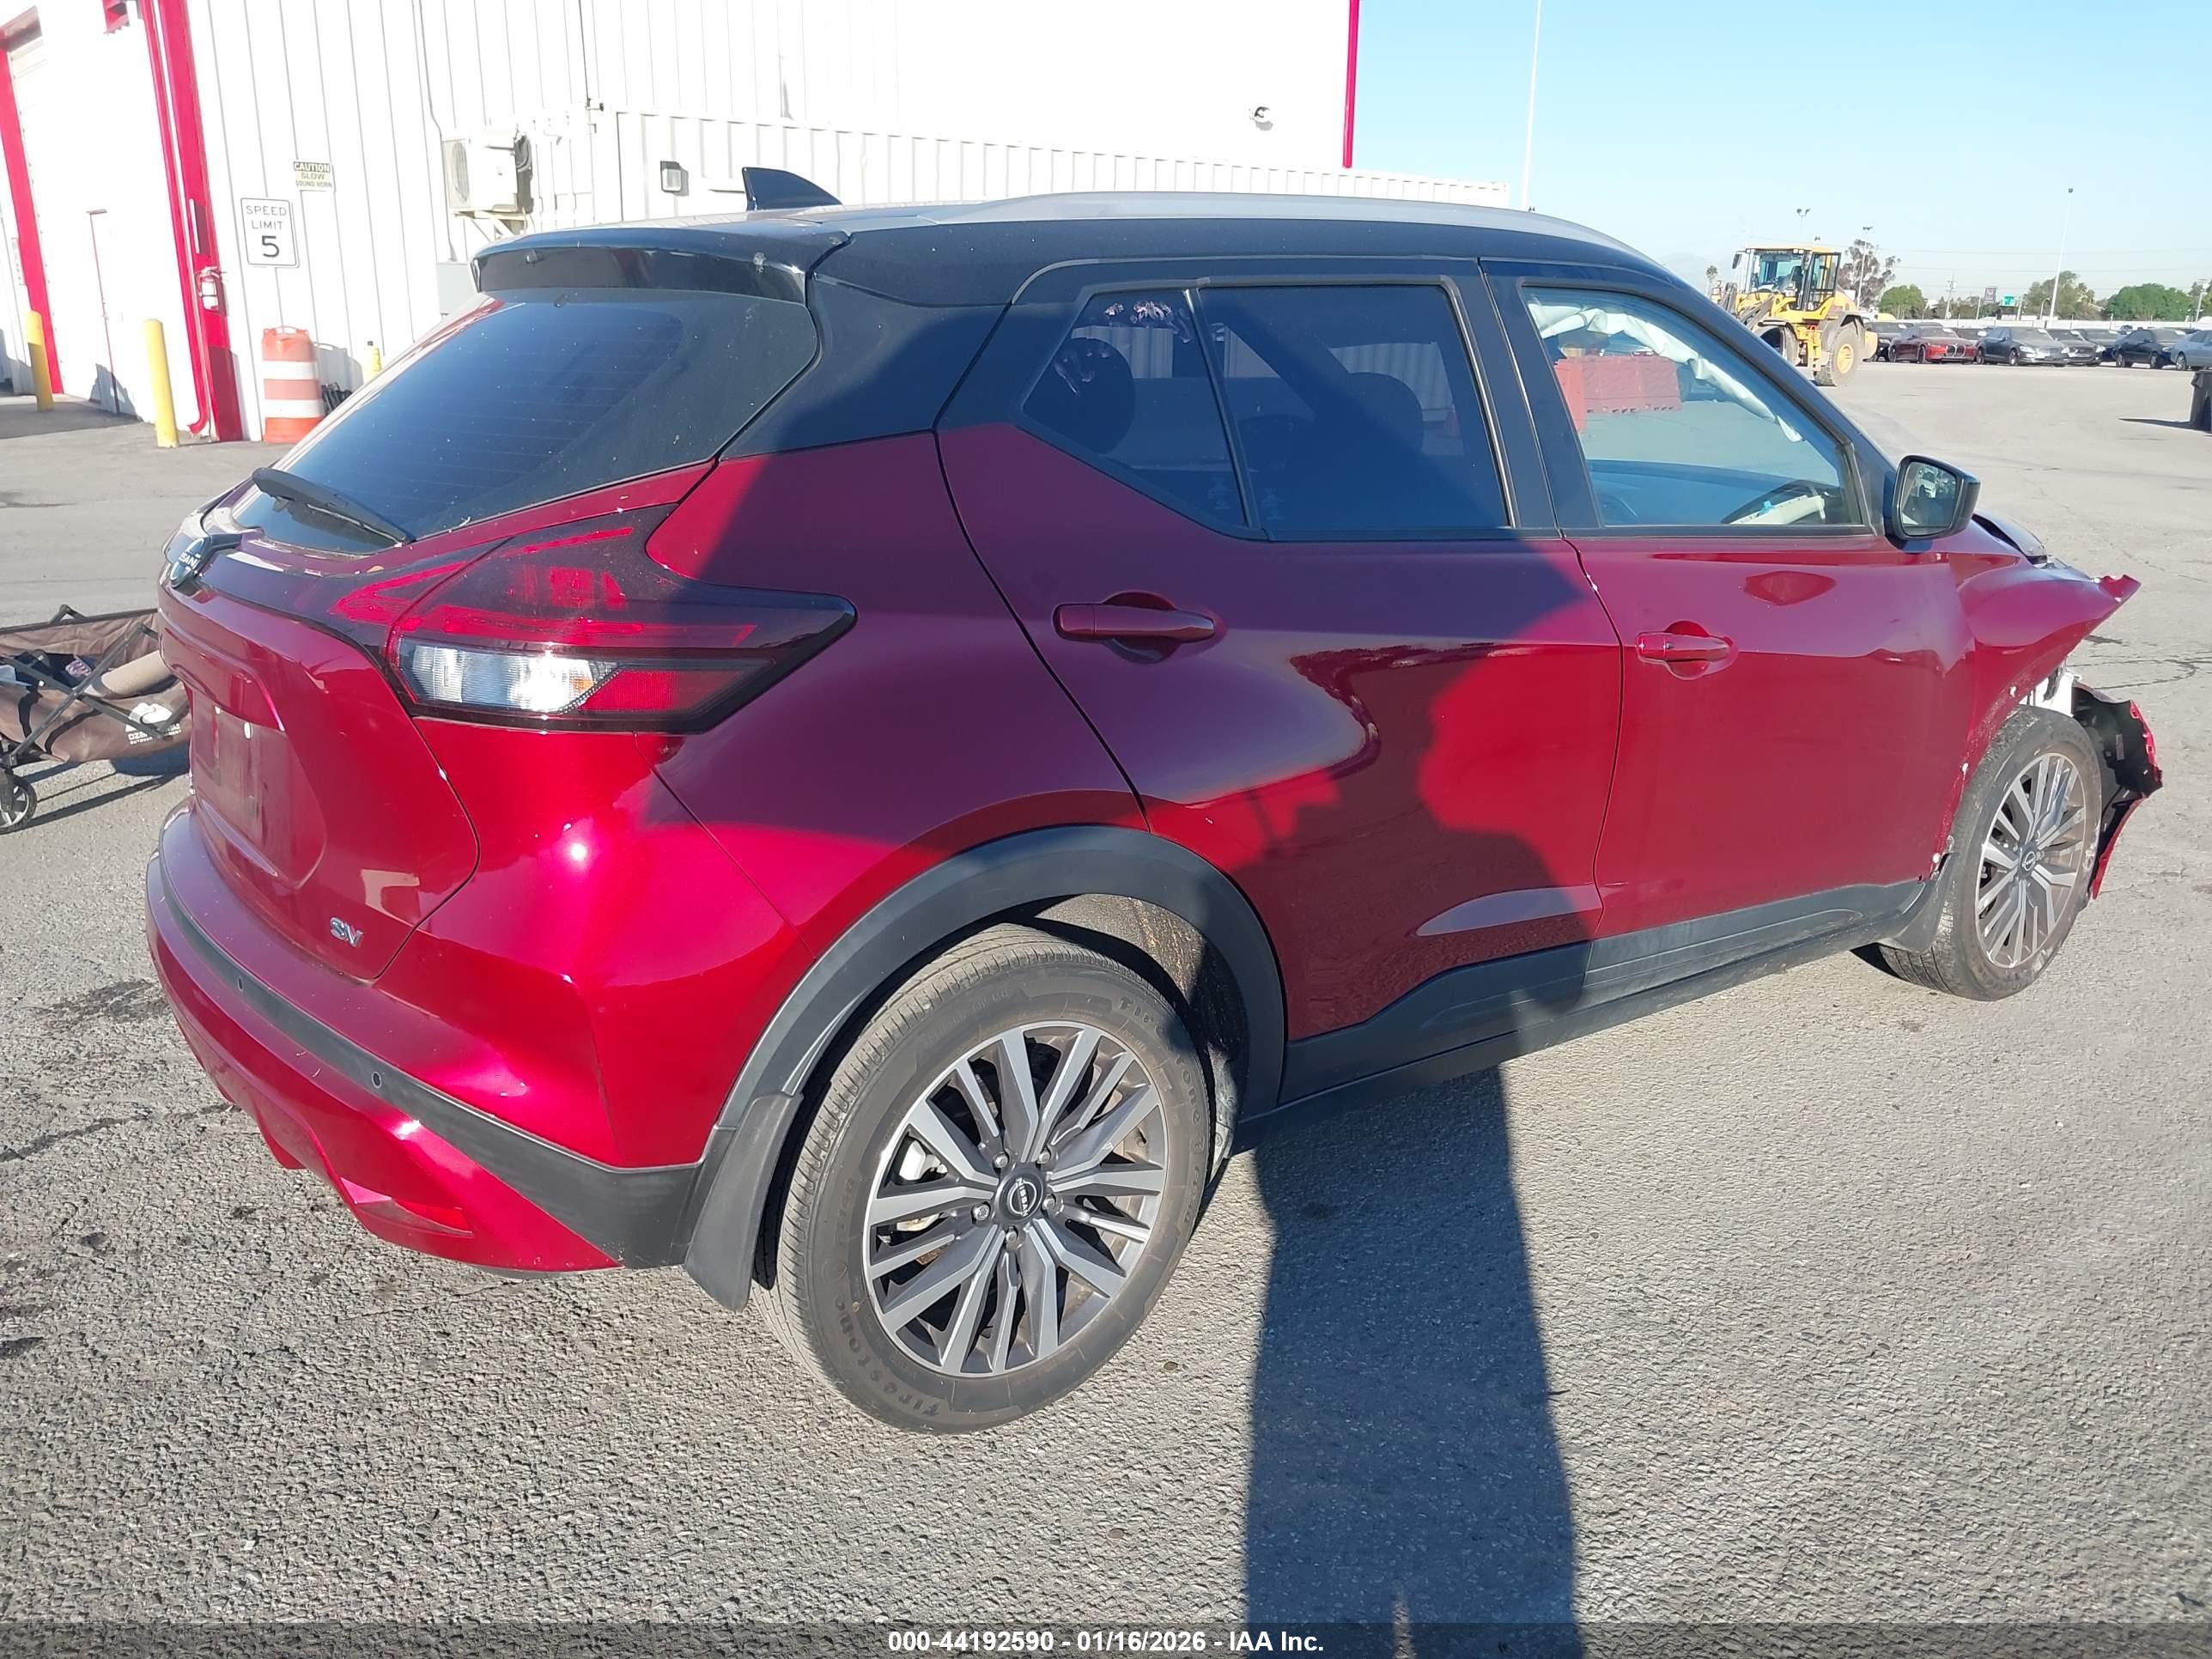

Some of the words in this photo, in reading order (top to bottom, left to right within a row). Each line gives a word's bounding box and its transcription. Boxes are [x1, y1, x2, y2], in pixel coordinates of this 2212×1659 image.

[295, 162, 330, 173] CAUTION
[246, 205, 287, 216] SPEED
[252, 220, 283, 230] LIMIT
[261, 235, 280, 258] 5
[331, 916, 364, 947] SV
[1017, 1177, 1029, 1216] NISSAN
